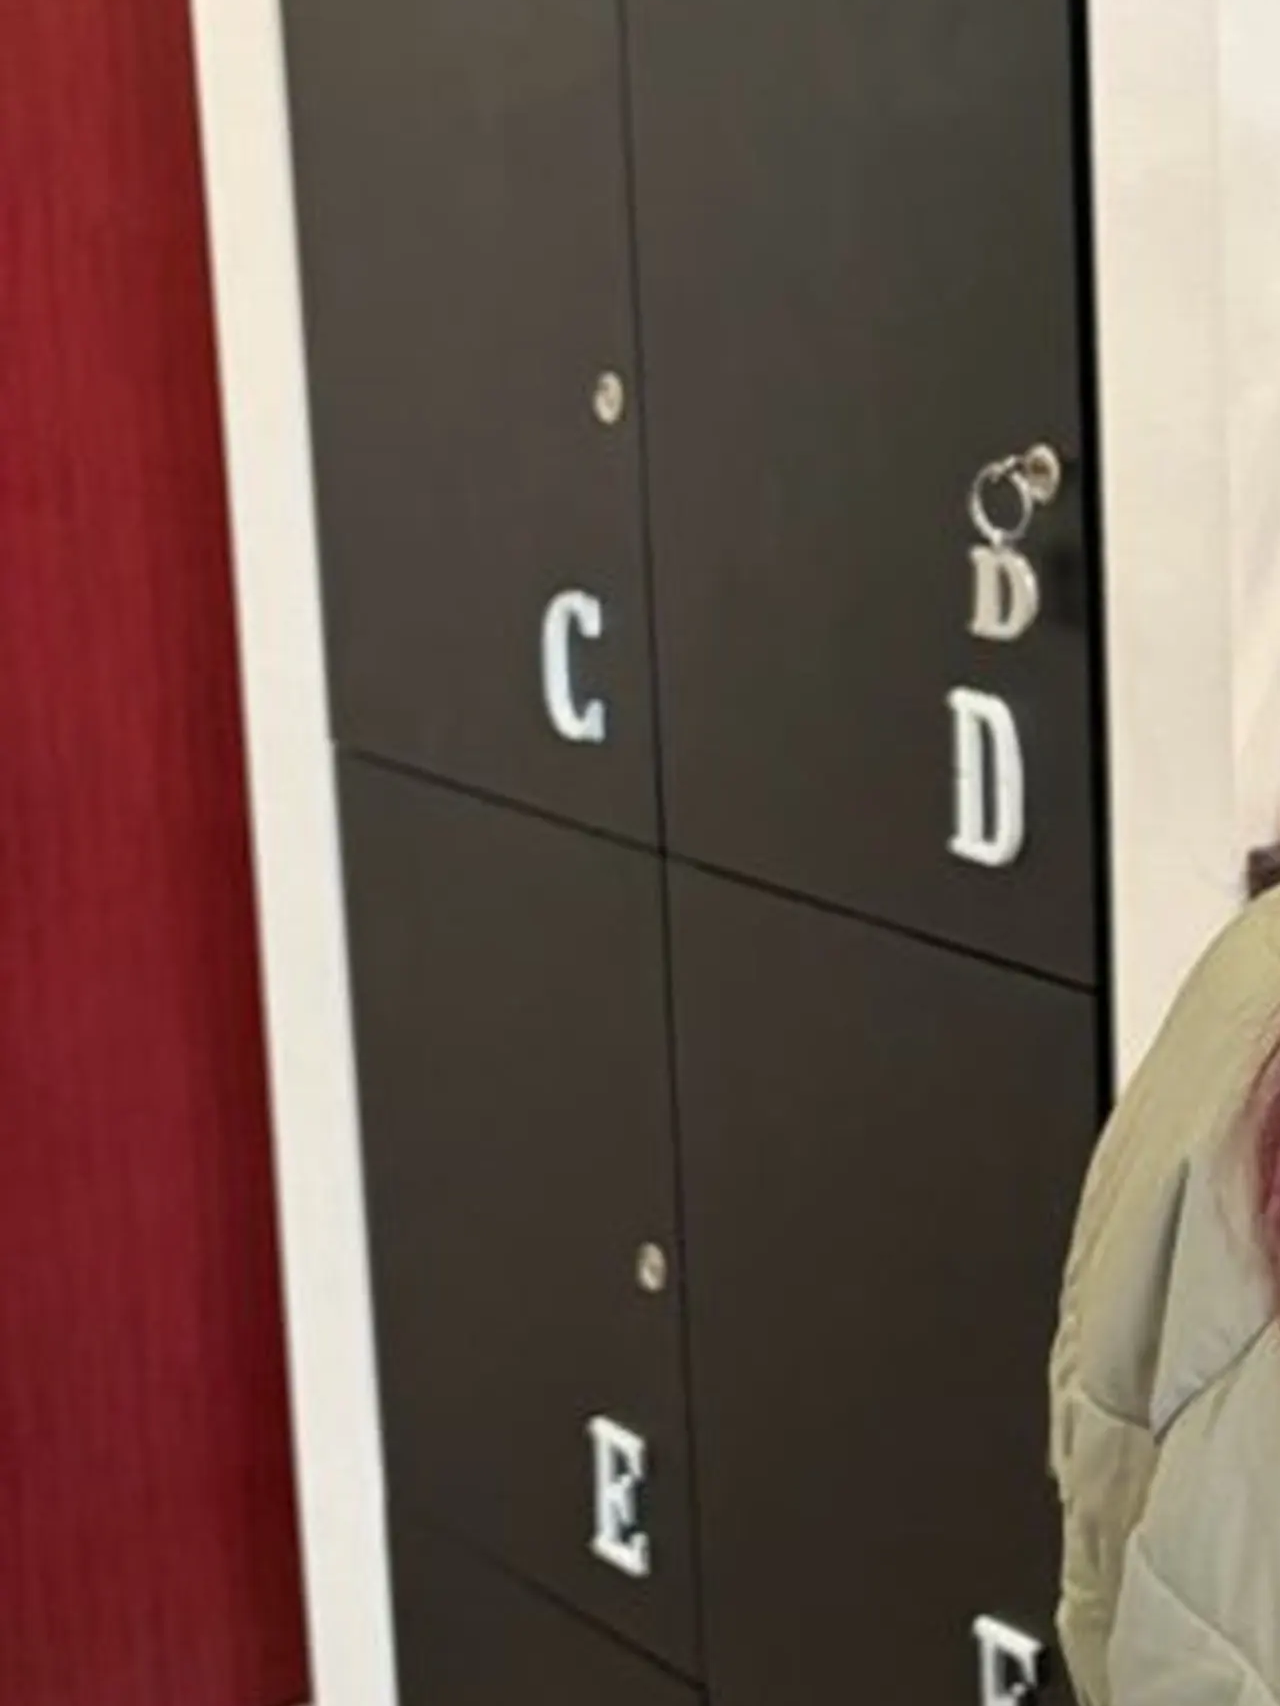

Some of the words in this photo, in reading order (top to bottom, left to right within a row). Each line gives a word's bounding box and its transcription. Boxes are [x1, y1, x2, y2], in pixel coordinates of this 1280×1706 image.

[541, 589, 607, 742] C
[967, 545, 1040, 641] D
[946, 685, 1025, 868] D
[588, 1415, 650, 1576] E
